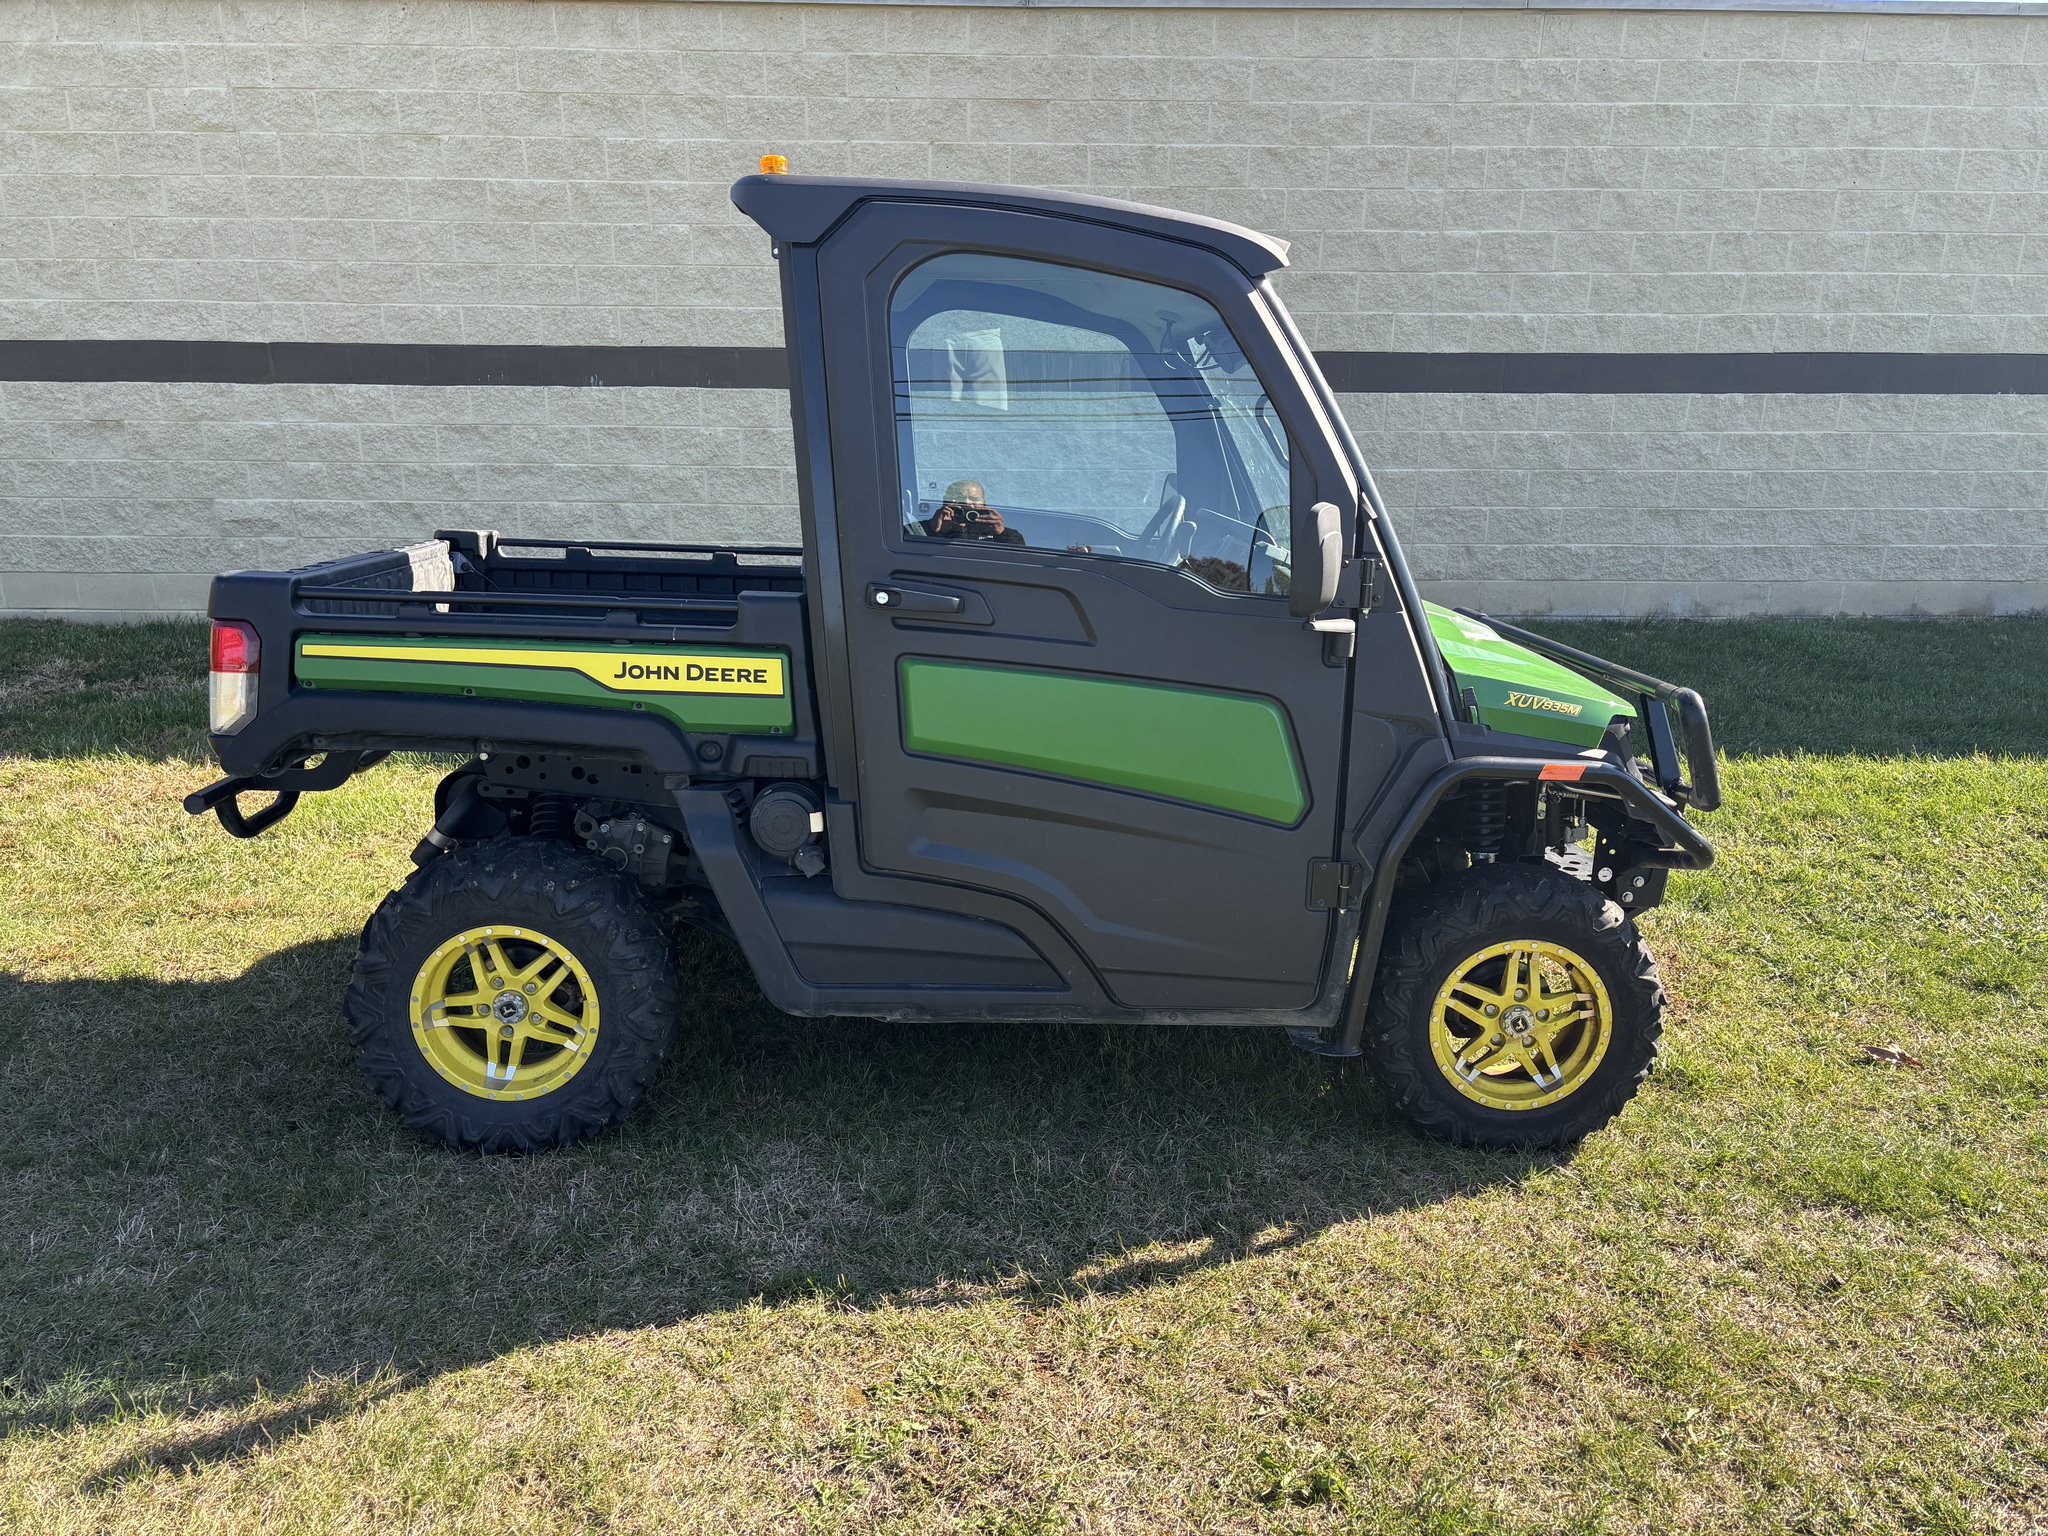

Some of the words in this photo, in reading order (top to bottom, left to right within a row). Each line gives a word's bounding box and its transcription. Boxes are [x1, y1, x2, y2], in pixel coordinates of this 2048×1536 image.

[614, 661, 680, 681] JOHN
[686, 664, 767, 683] DEERE
[1503, 692, 1581, 716] XUV835M
